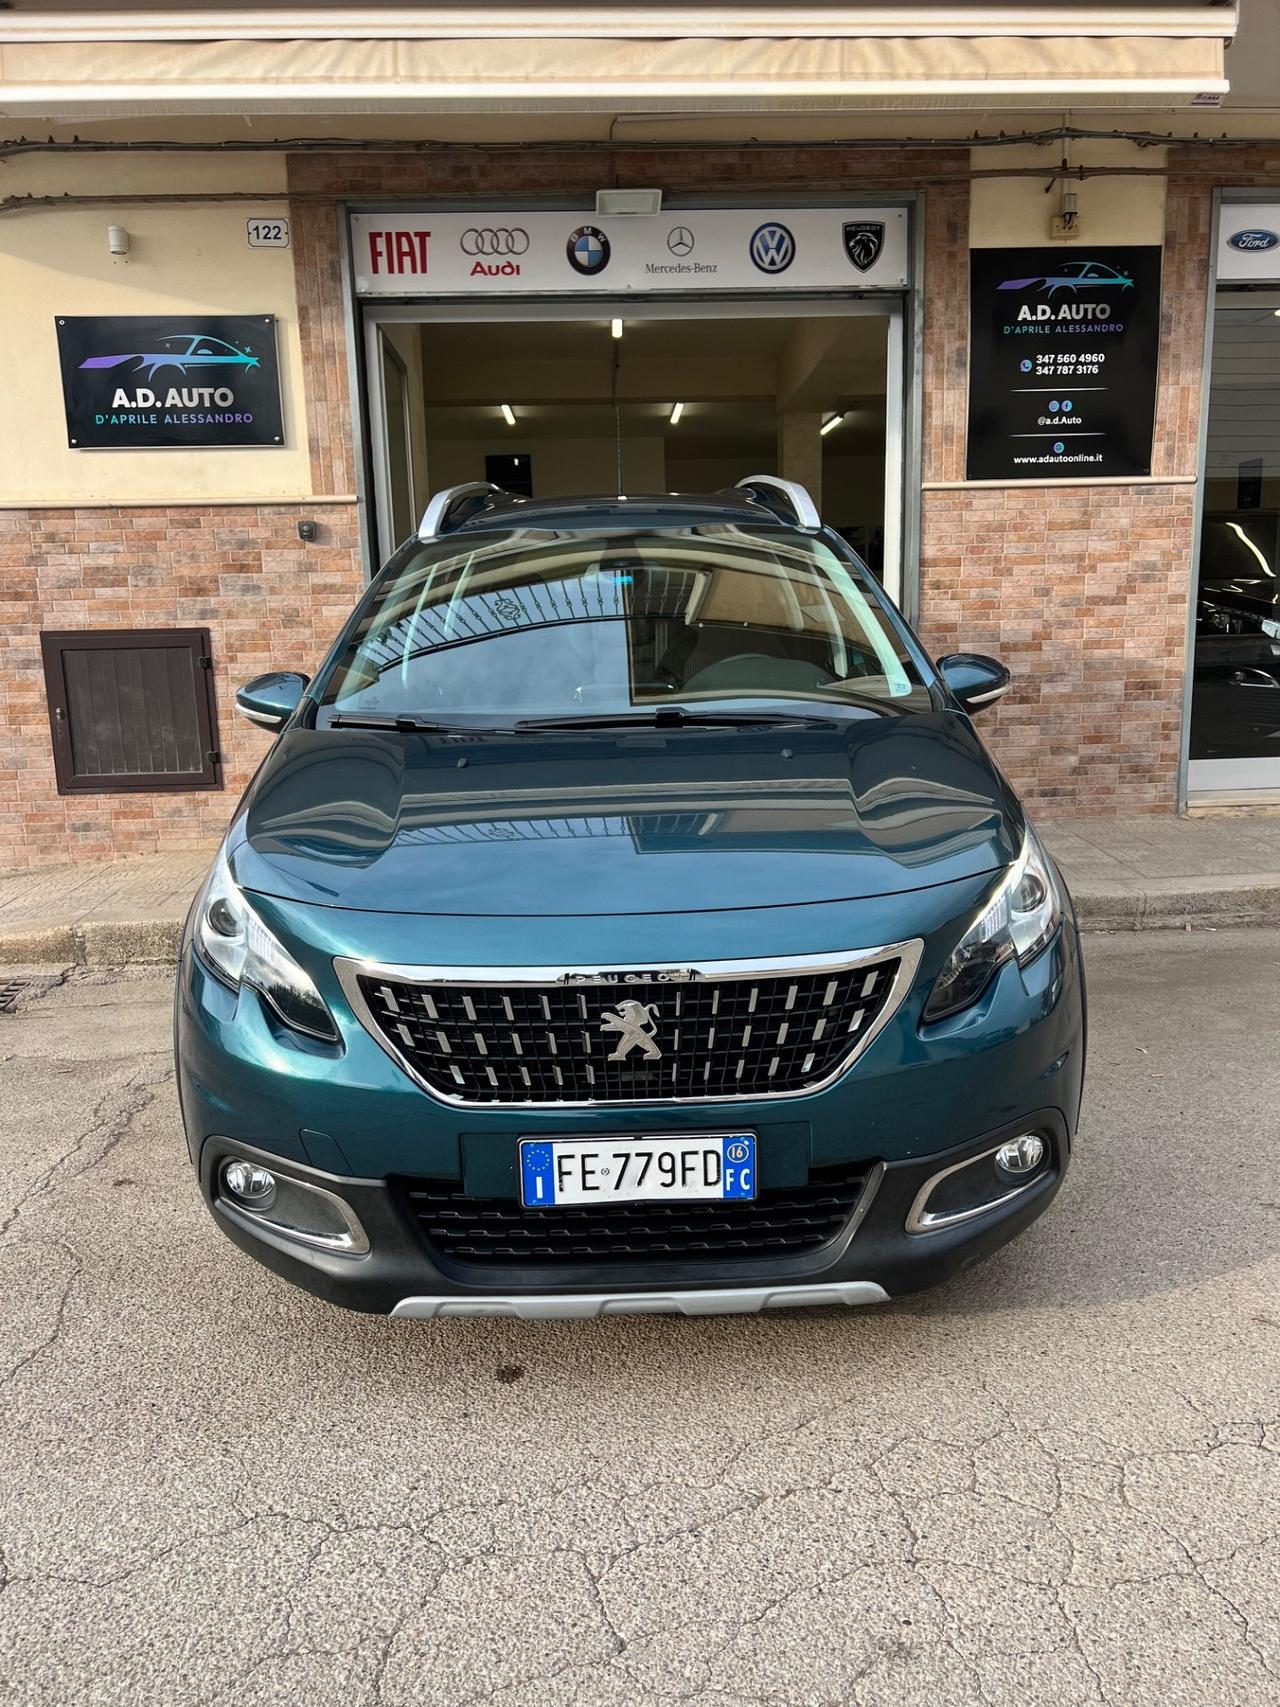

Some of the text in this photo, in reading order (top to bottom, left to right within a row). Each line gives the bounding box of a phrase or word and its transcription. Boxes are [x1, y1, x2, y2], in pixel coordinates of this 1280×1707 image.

[252, 225, 282, 240] 122
[570, 226, 607, 243] BMW
[1238, 233, 1270, 249] Ford
[368, 231, 431, 274] FIAT
[470, 261, 520, 276] Audi
[645, 263, 718, 274] Mercedes-Benz
[1017, 303, 1111, 321] A.D. AUTO
[1003, 323, 1124, 334] D'APRILE ALESSANDRO
[1036, 353, 1105, 364] 347 560 4960
[1035, 365, 1099, 376] 347 787 3176
[112, 387, 234, 408] A.D. AUTO
[95, 413, 253, 425] D'APRILE ALESSANDRO
[1037, 416, 1082, 426] @a.d.Auto
[1014, 454, 1103, 465] www.adautoonline.it
[574, 974, 684, 985] PEUGEO
[731, 1146, 743, 1159] 16
[557, 1149, 722, 1192] FE 779FD
